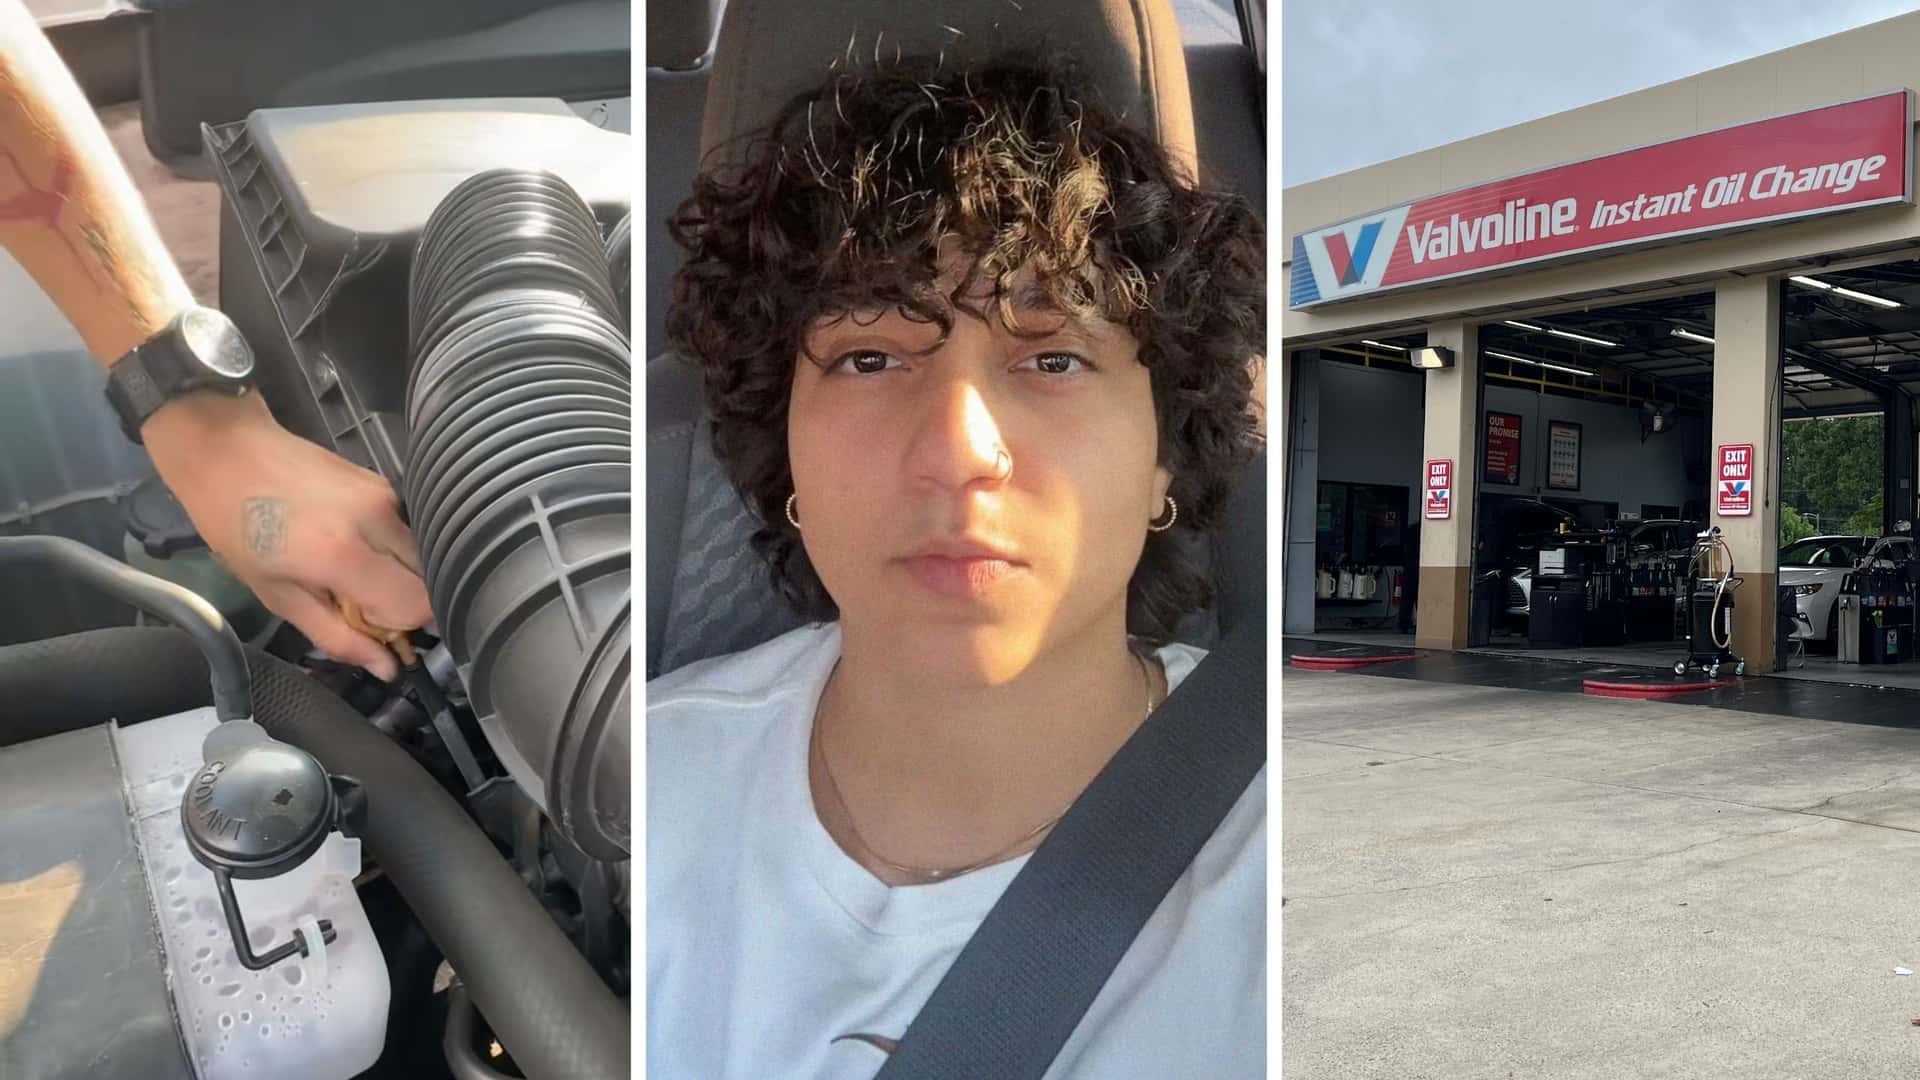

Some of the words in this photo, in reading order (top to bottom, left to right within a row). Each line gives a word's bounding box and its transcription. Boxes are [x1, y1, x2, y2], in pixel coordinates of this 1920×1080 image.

[1407, 198, 1577, 264] Valvoline
[1590, 183, 1697, 229] Instant
[1701, 172, 1747, 209] Oil
[1749, 154, 1887, 194] Change
[1489, 416, 1505, 426] OUR
[1489, 426, 1520, 439] PROMISE
[1725, 450, 1747, 463] EXIT
[1431, 464, 1447, 475] EXIT
[1723, 463, 1748, 477] ONLY
[1430, 476, 1448, 487] ONLY
[194, 760, 249, 841] COOLANT
